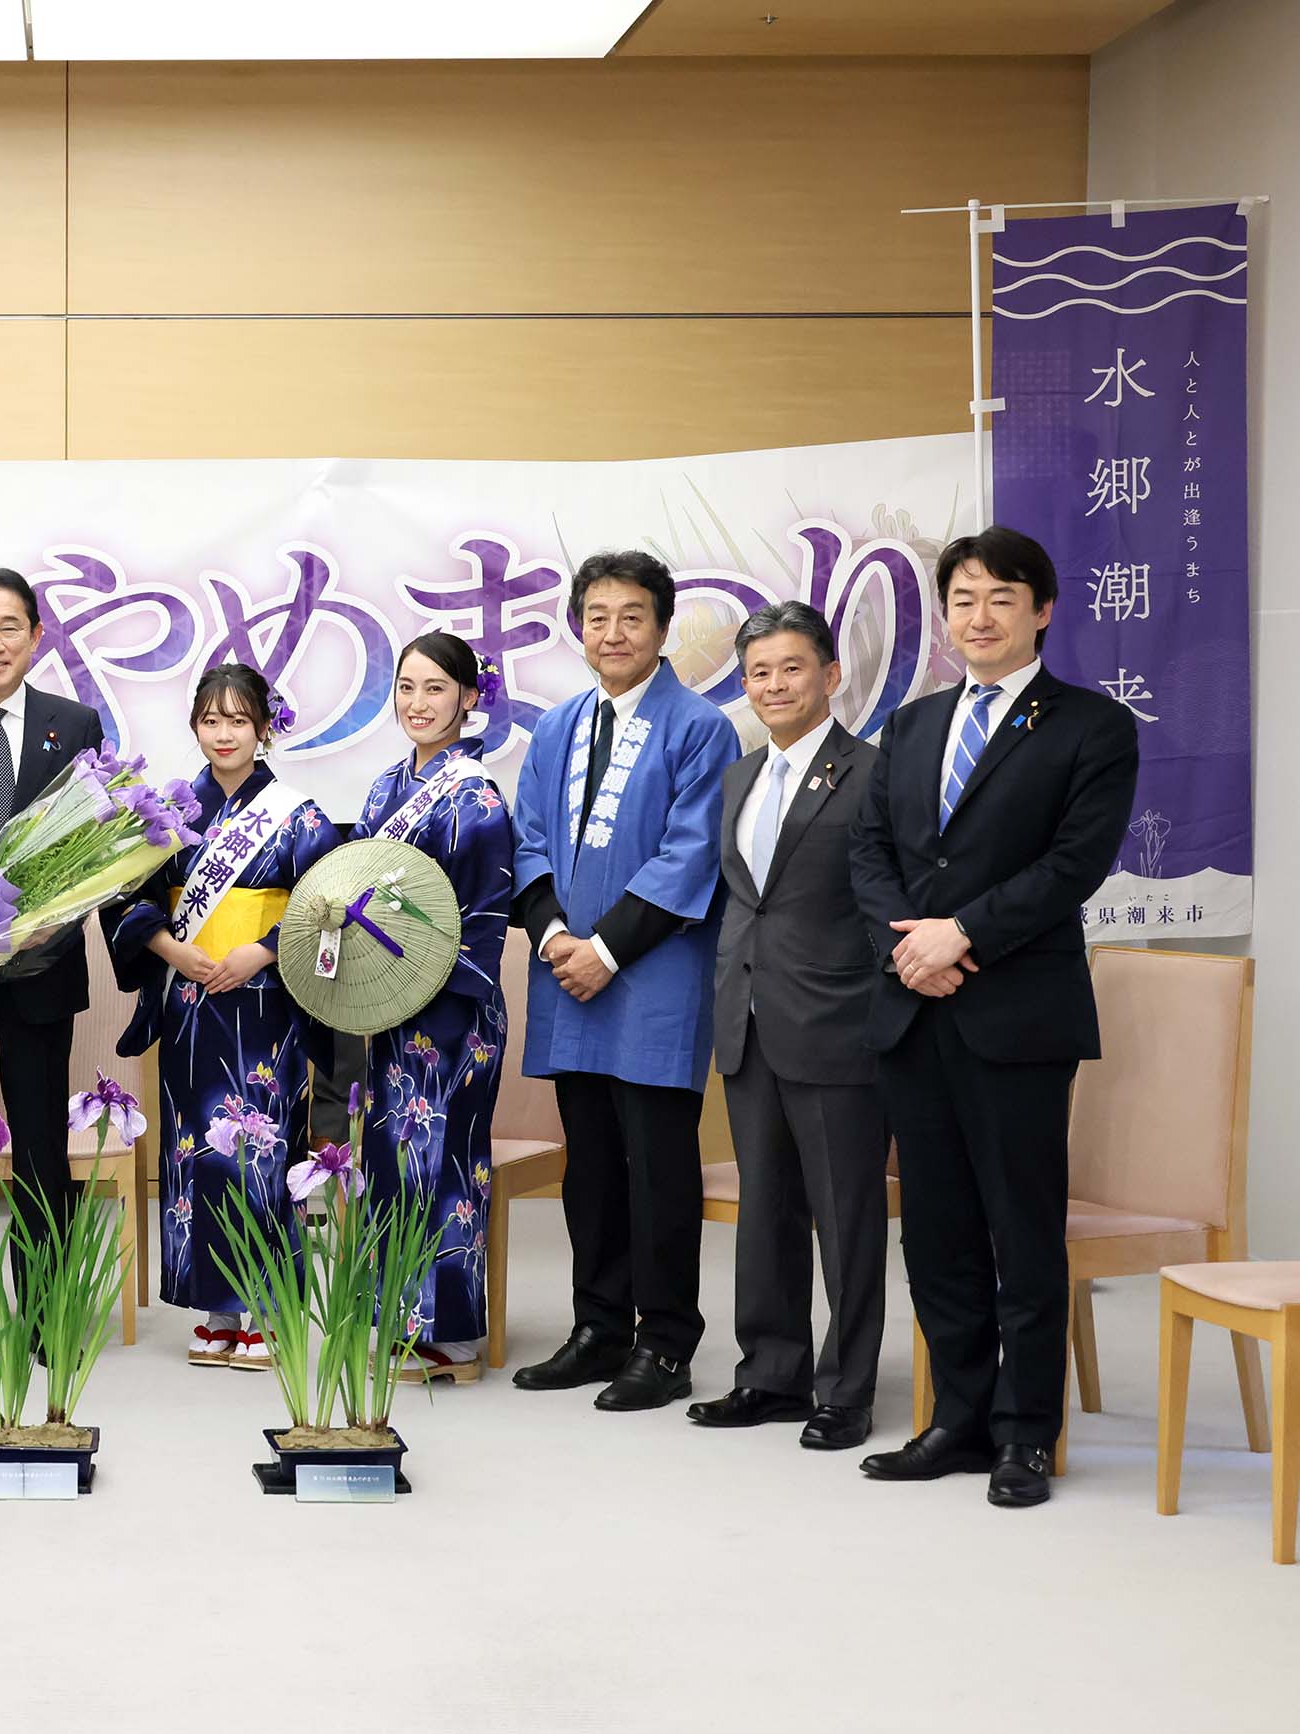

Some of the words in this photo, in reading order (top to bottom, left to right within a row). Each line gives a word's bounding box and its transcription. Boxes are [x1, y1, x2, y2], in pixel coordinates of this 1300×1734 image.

[1083, 347, 1160, 723] 水郷潮来
[1183, 351, 1201, 604] 人と人とが出逢うまち
[1129, 894, 1172, 902] いたこ
